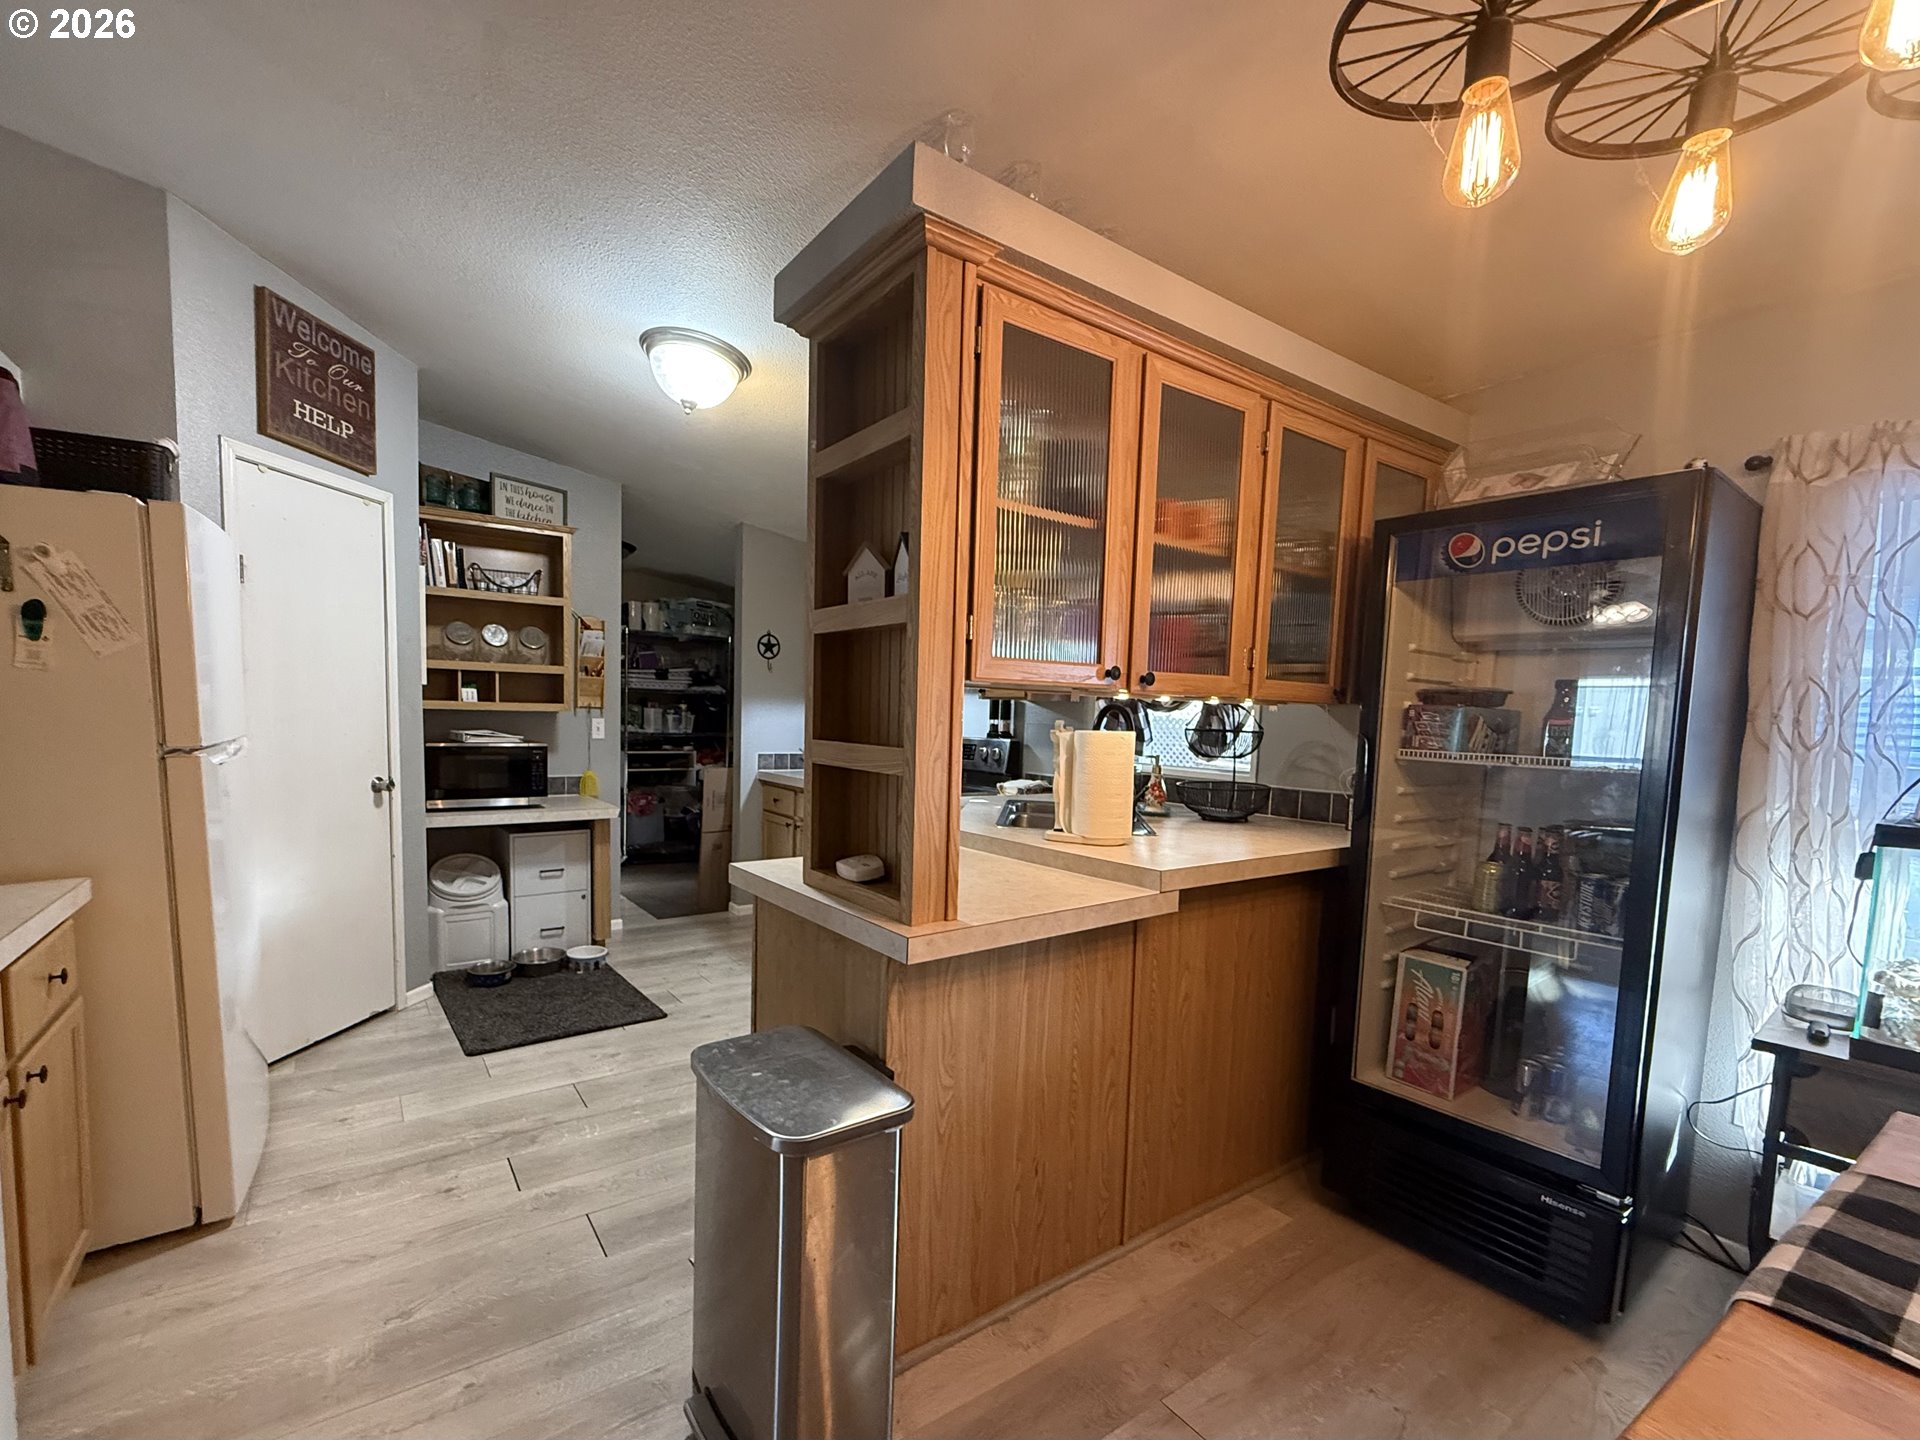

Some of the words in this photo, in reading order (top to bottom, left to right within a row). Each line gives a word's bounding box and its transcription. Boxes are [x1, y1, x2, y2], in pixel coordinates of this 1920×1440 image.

[272, 297, 372, 375] Welcome
[275, 351, 371, 420] Kitchen
[288, 342, 319, 367] To
[328, 364, 364, 393] Our
[293, 399, 355, 439] HELP
[500, 481, 508, 492] IN
[510, 484, 524, 496] THIS
[524, 488, 555, 503] house
[505, 495, 514, 505] WE
[515, 496, 544, 512] dance
[545, 504, 553, 514] IN
[505, 507, 515, 518] THE
[517, 507, 552, 524] kitchen
[1491, 520, 1602, 564] pepsi
[1576, 880, 1595, 928] KEYSTONE
[1541, 1194, 1586, 1218] Hisense
